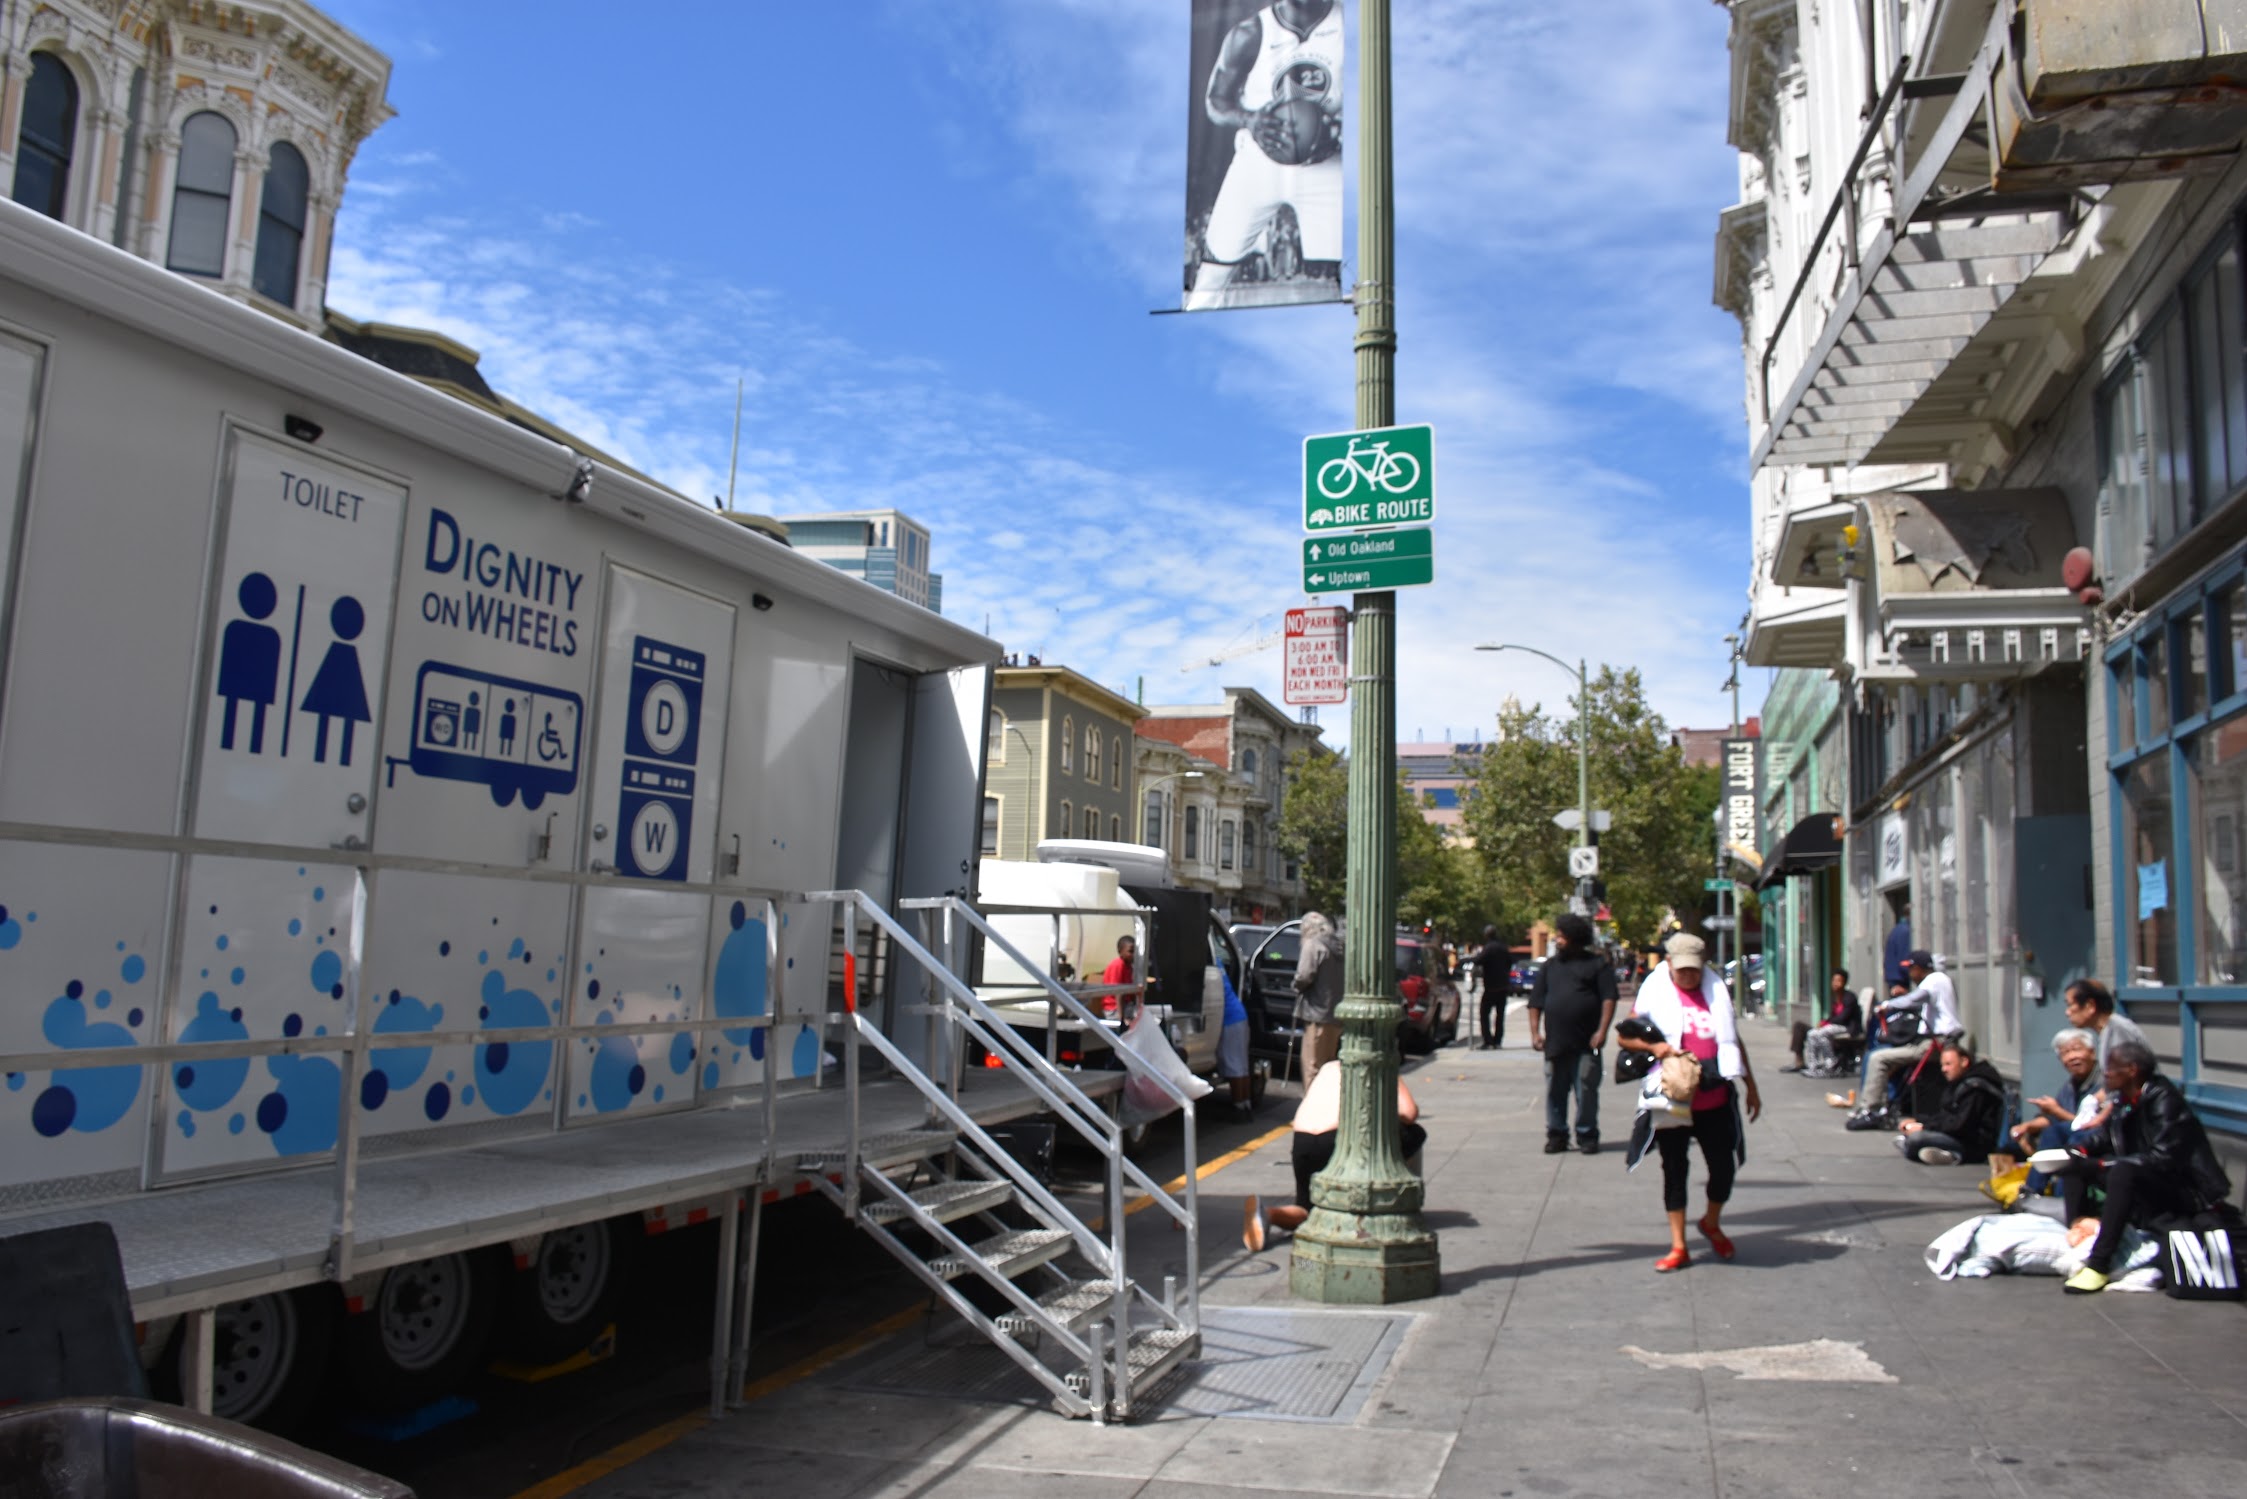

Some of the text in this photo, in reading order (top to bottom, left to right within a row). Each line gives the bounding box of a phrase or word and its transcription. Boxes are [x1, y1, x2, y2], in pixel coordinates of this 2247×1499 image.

[1301, 69, 1325, 87] 23
[280, 470, 365, 522] TOILET
[1334, 498, 1430, 524] BIKE ROUTE
[425, 507, 584, 612] DIGNITY
[1328, 539, 1395, 557] Old Oakland
[1328, 571, 1371, 587] Uptown
[422, 590, 578, 657] ON WHEELS
[1286, 613, 1345, 634] NO PARKING
[1314, 641, 1327, 652] AM
[1330, 640, 1341, 652] TO
[1321, 653, 1334, 664] AM
[1288, 679, 1344, 691] EACH MONTH
[656, 699, 674, 736] D
[1727, 742, 1755, 791] FORT
[645, 821, 667, 853] W
